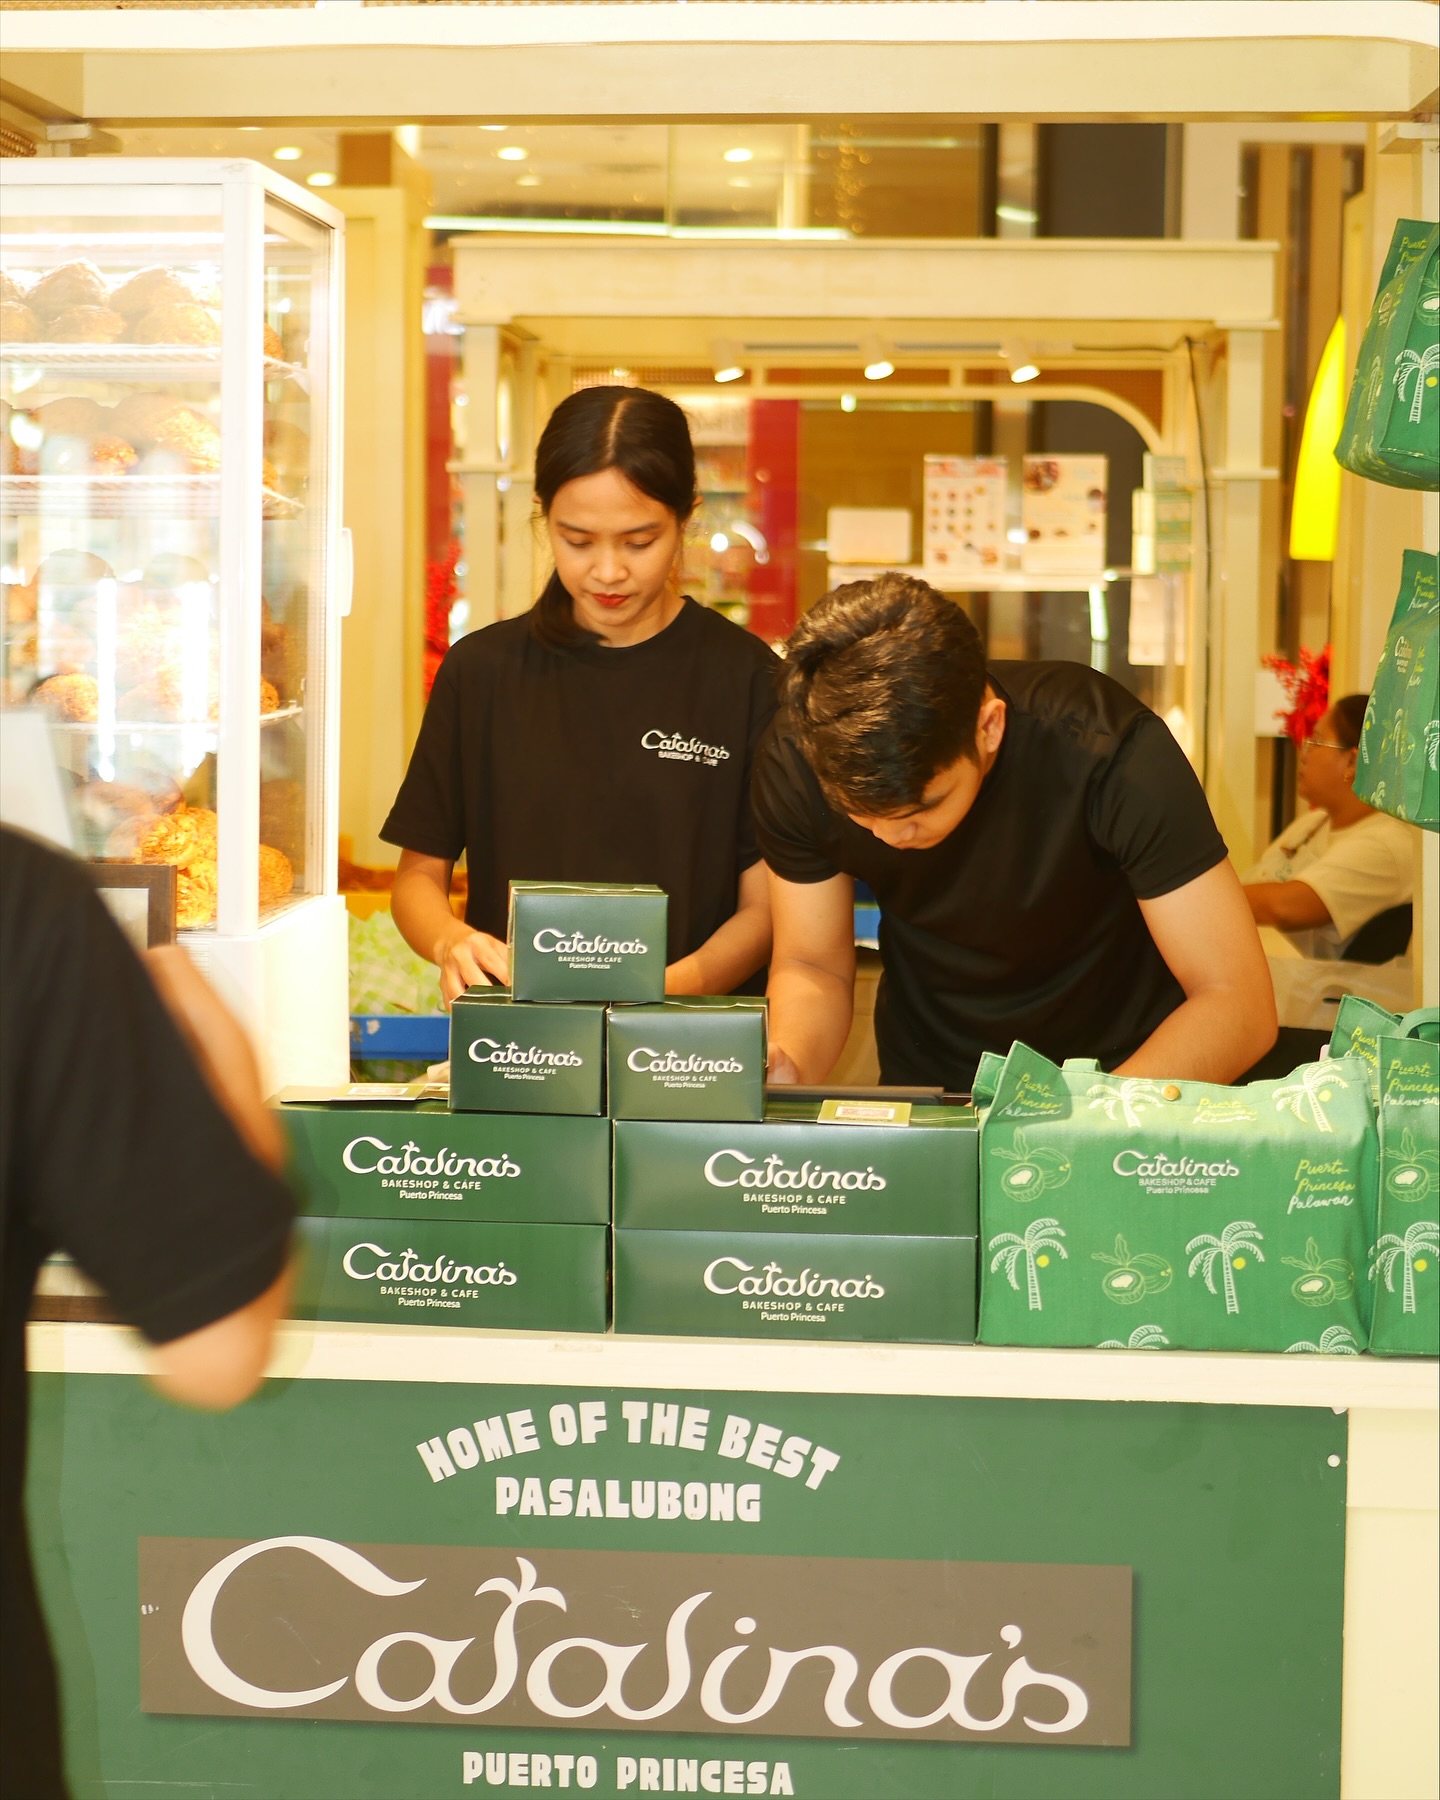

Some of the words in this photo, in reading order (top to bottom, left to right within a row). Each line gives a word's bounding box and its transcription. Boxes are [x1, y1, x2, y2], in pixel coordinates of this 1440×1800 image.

[641, 729, 730, 759] Catalina's
[533, 928, 648, 954] Catalina's
[468, 1038, 583, 1066] Catalina's
[627, 1047, 743, 1073] Catalina's
[343, 1136, 521, 1178] Catalina's
[704, 1149, 886, 1190] Catalina's
[1112, 1150, 1239, 1177] Catalina's
[1294, 1159, 1349, 1180] Puerto
[382, 1179, 439, 1188] BAKESHOP
[443, 1181, 450, 1189] &
[400, 1191, 428, 1199] Puerto
[429, 1191, 463, 1200] Princesa
[1297, 1179, 1355, 1195] Princesa
[743, 1194, 802, 1203] BAKESHOP
[806, 1195, 814, 1203] &
[818, 1196, 846, 1204] CAFE
[762, 1205, 790, 1214] Puerto
[791, 1205, 827, 1215] Princesa
[1287, 1194, 1354, 1215] Palawan
[343, 1242, 517, 1286] Catalina's
[704, 1257, 885, 1298] Catalina's
[380, 1287, 437, 1297] BAKESHOP
[440, 1289, 448, 1297] &
[452, 1290, 479, 1298] CAFE
[398, 1298, 425, 1307] Puerto
[427, 1299, 460, 1308] Princesa
[742, 1301, 801, 1310] BAKESHOP
[805, 1303, 812, 1311] &
[816, 1303, 845, 1312] CAFE
[761, 1312, 789, 1321] Puerto
[790, 1313, 826, 1322] Princesa
[415, 1408, 540, 1483] HOME
[548, 1400, 608, 1446] OF
[621, 1400, 710, 1451] THE
[717, 1414, 841, 1491] BEST
[495, 1476, 760, 1522] PASALUBONG
[181, 1535, 1089, 1734] Catalina's
[461, 1751, 598, 1789] PUERTO
[616, 1756, 794, 1795] PRINCESA
